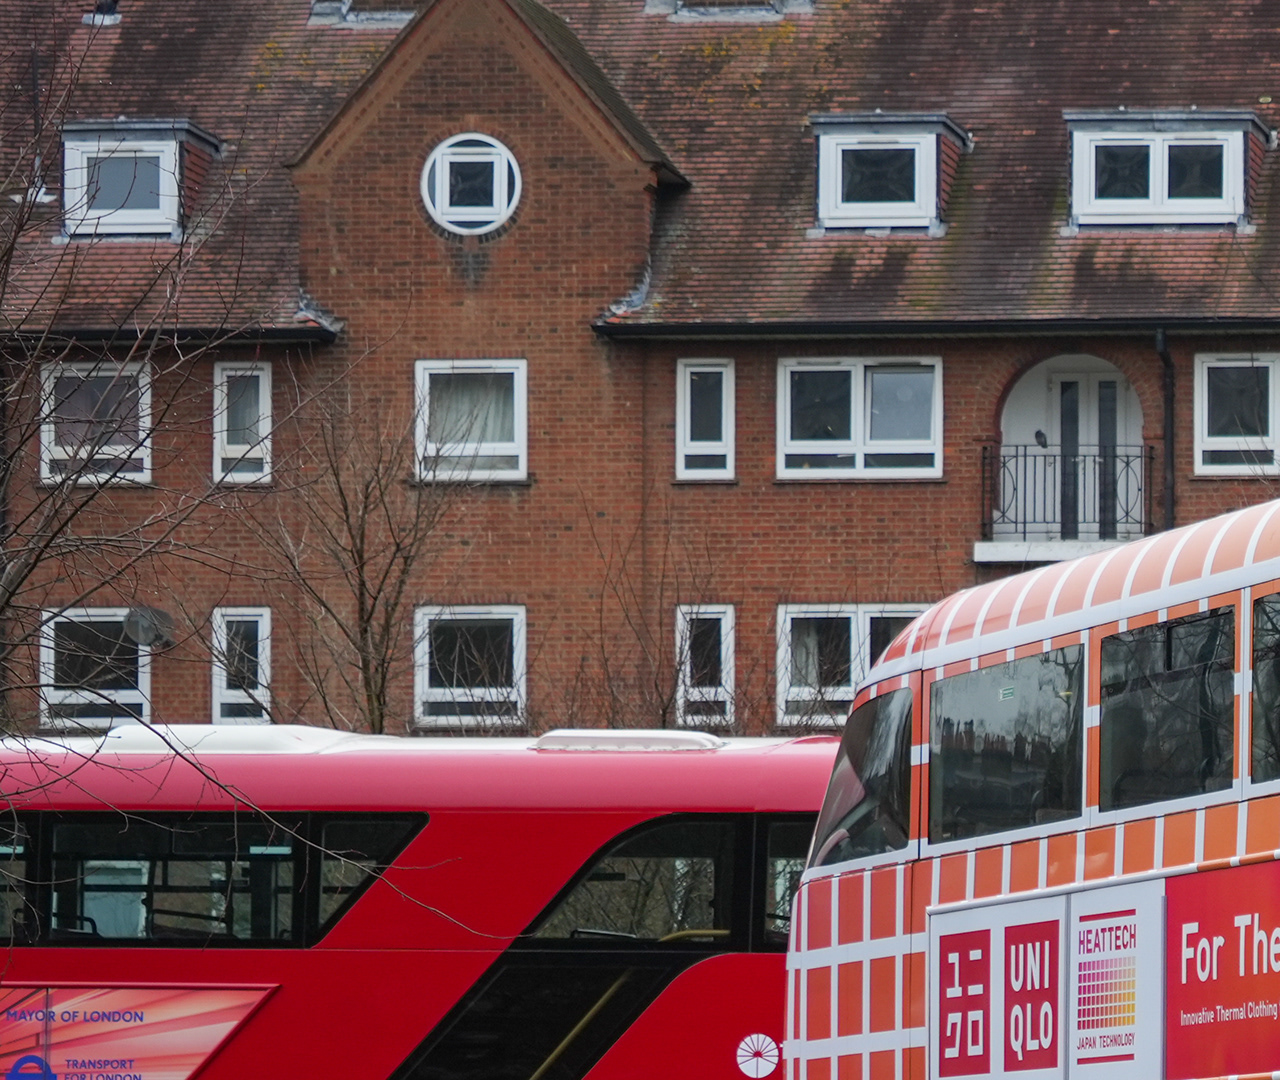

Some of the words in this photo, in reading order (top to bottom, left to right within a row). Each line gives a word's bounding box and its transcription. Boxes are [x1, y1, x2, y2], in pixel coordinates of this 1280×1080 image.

[1078, 923, 1137, 955] HEATTECH
[1181, 921, 1225, 985] For
[946, 949, 984, 998] ユニ
[1010, 940, 1050, 992] UNI
[6, 1010, 56, 1022] MAYOR
[60, 1010, 79, 1022] OF
[83, 1010, 144, 1023] LONDON
[1010, 1001, 1053, 1061] QLO
[1180, 1007, 1214, 1027] Innovative
[1216, 1003, 1247, 1023] Thermal
[1247, 999, 1278, 1020] Clothing
[944, 1010, 984, 1059] クロ
[1076, 1035, 1097, 1051] JAPAN
[1099, 1032, 1135, 1048] TECHNOLOGY
[65, 1059, 135, 1069] TRANSPORT
